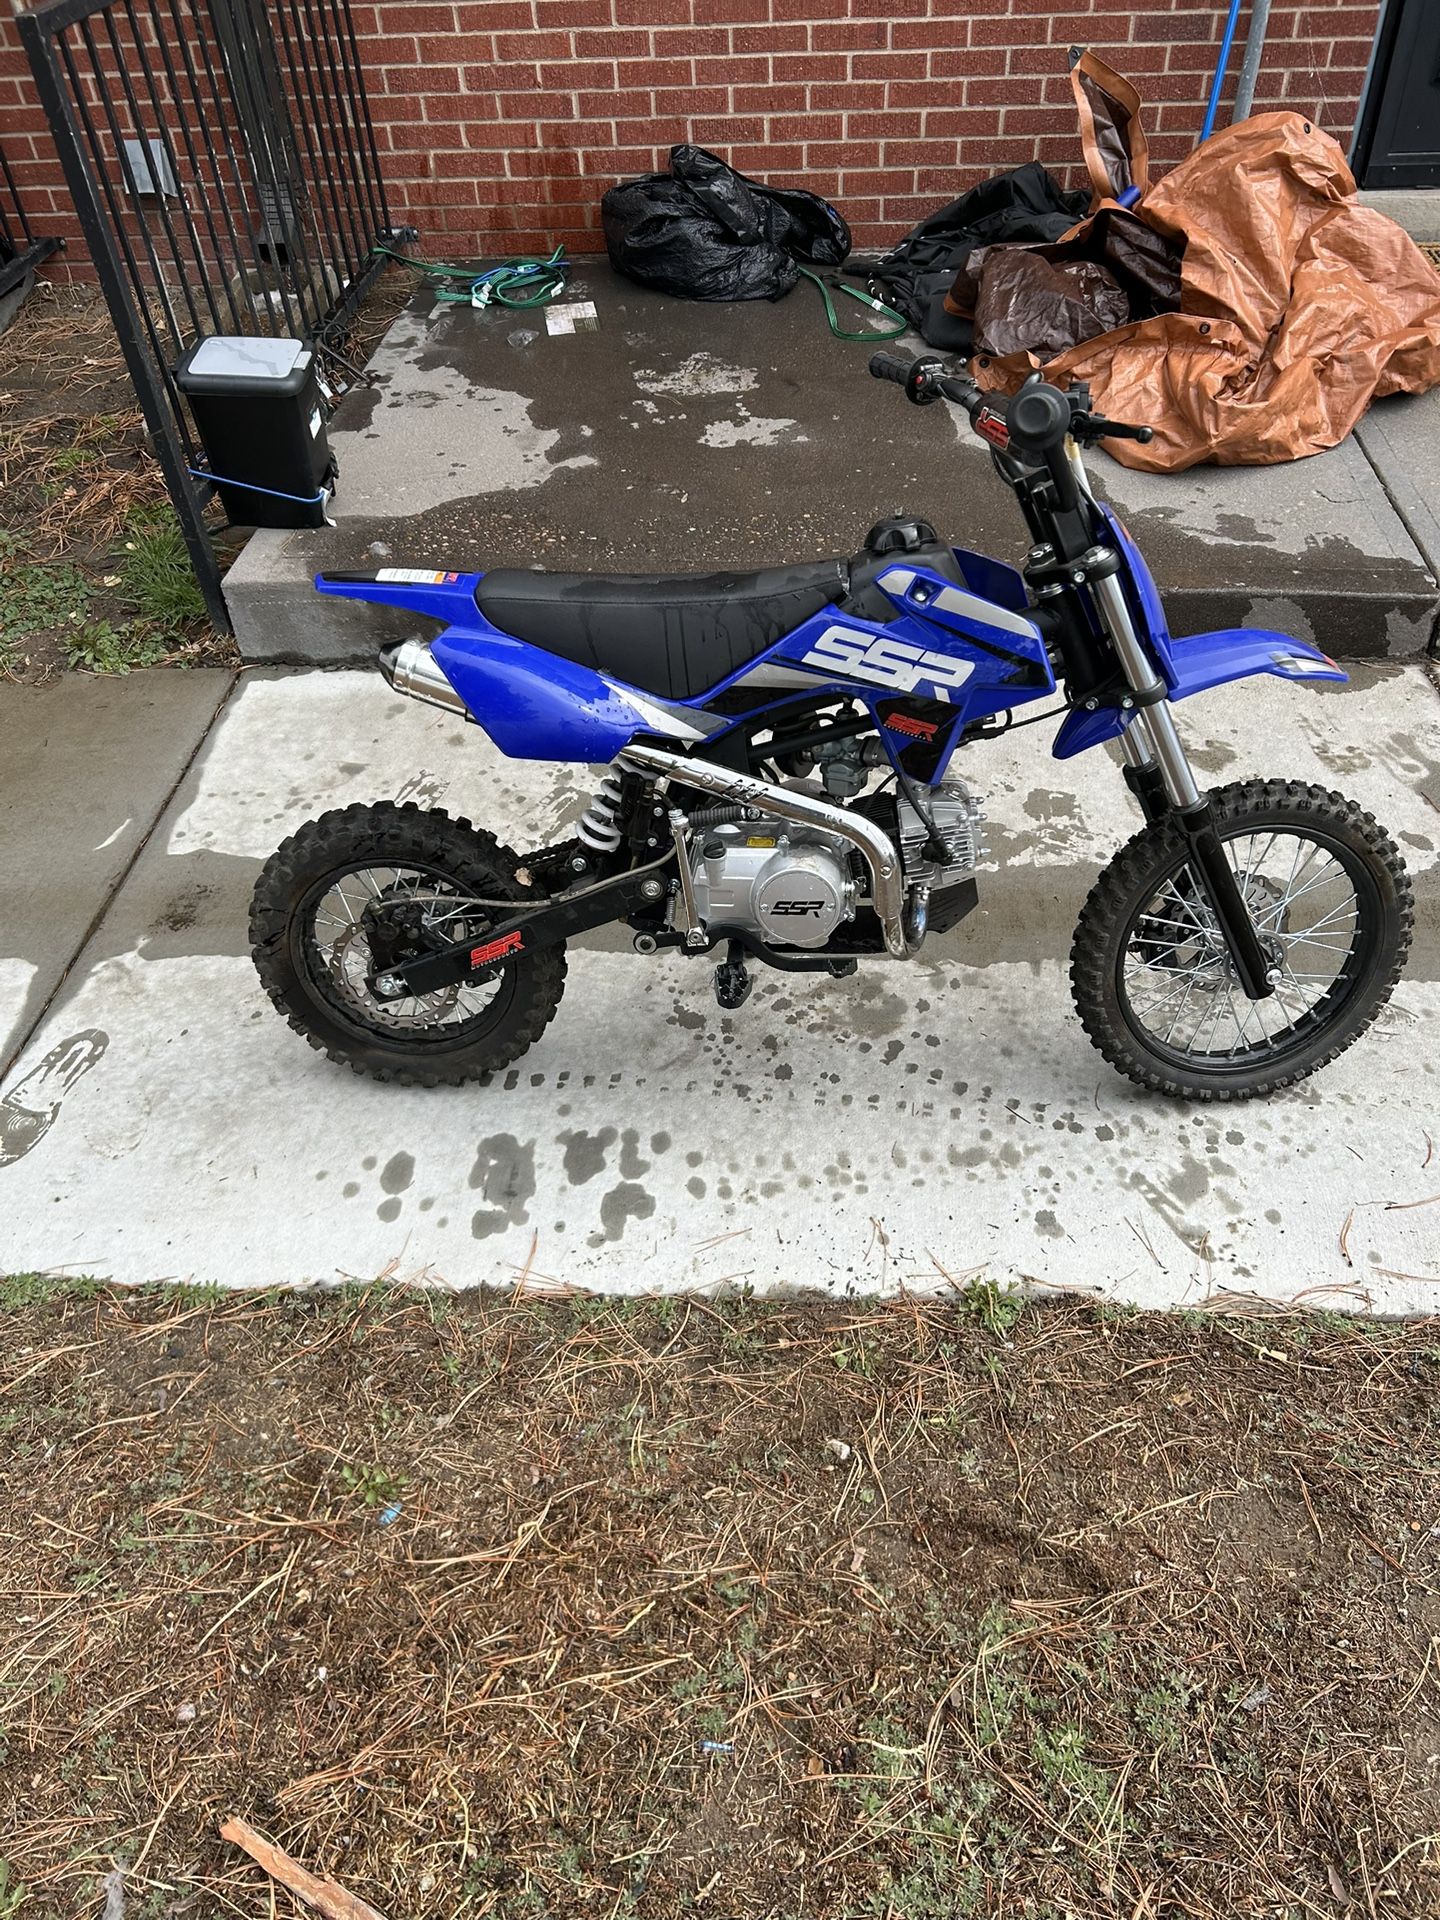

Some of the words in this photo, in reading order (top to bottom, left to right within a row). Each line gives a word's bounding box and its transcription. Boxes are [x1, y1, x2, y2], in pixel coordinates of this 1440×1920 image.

[801, 625, 976, 703] SSR
[884, 712, 939, 742] SSR
[770, 900, 825, 918] SSR
[470, 930, 526, 966] SSR
